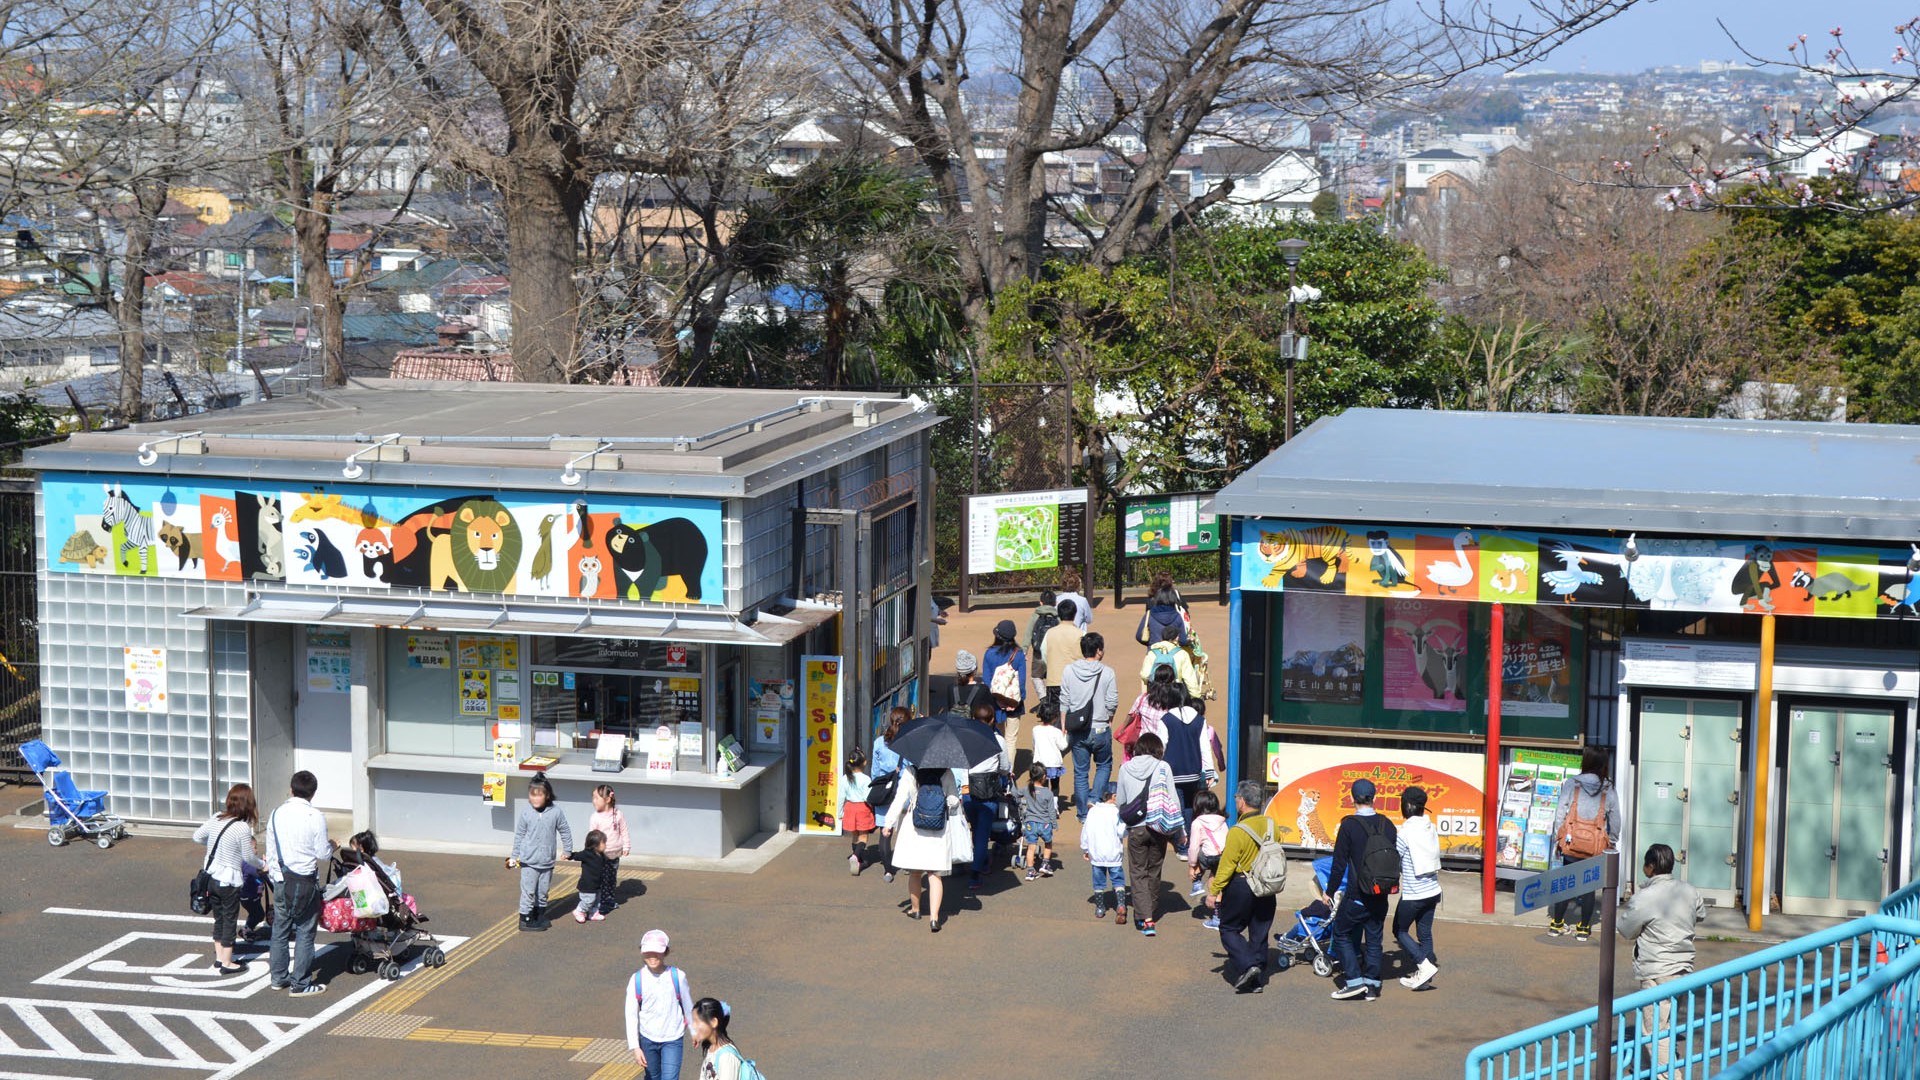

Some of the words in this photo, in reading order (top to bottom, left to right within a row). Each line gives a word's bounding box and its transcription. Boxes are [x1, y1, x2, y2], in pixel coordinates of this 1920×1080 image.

[1393, 600, 1422, 611] ZOO
[598, 648, 638, 657] information
[1283, 679, 1362, 692] 野毛山動物園
[1550, 874, 1576, 894] 展望台
[1583, 865, 1600, 884] 広場
